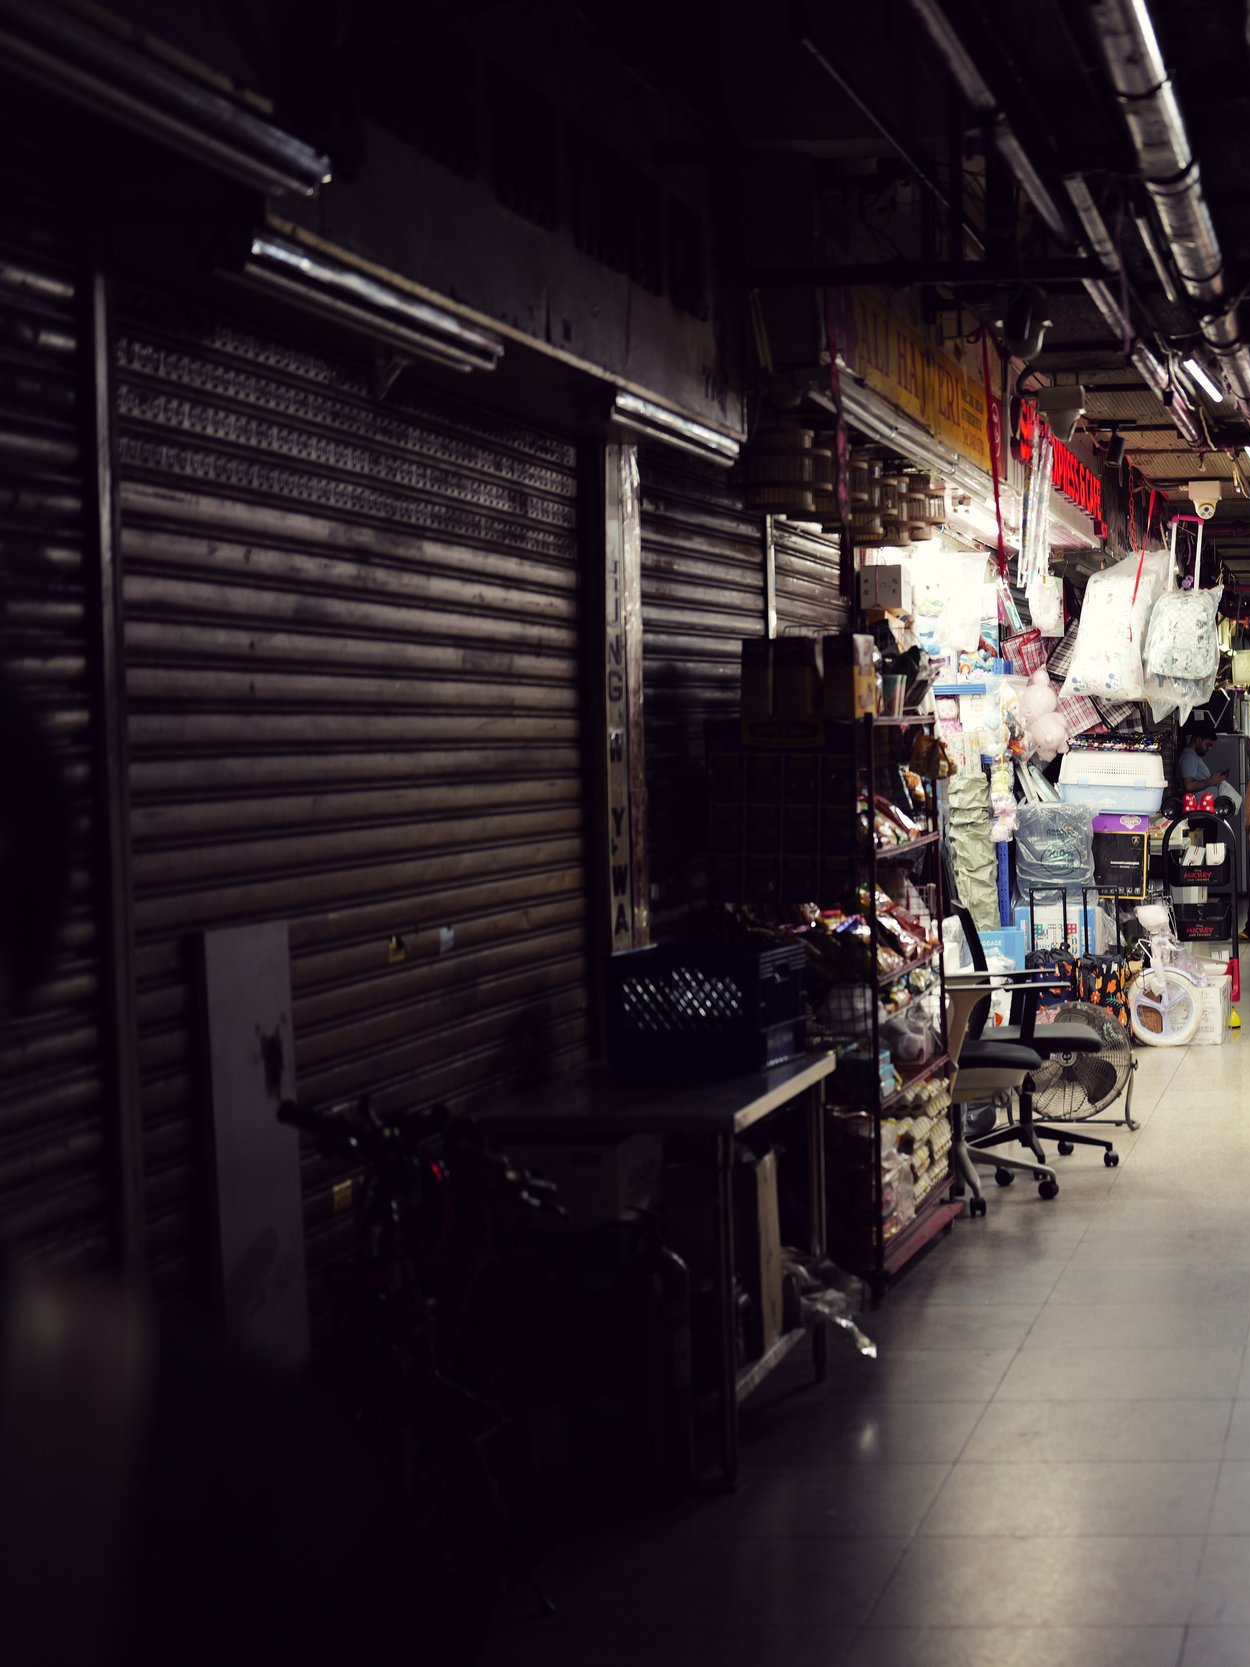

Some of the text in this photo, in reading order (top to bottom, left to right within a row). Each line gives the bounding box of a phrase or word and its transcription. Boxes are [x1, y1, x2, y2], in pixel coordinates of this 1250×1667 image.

[859, 303, 890, 378] ALI
[896, 329, 960, 427] HAJERI
[1049, 432, 1079, 504] XPRESS
[1184, 871, 1212, 879] MICKEY
